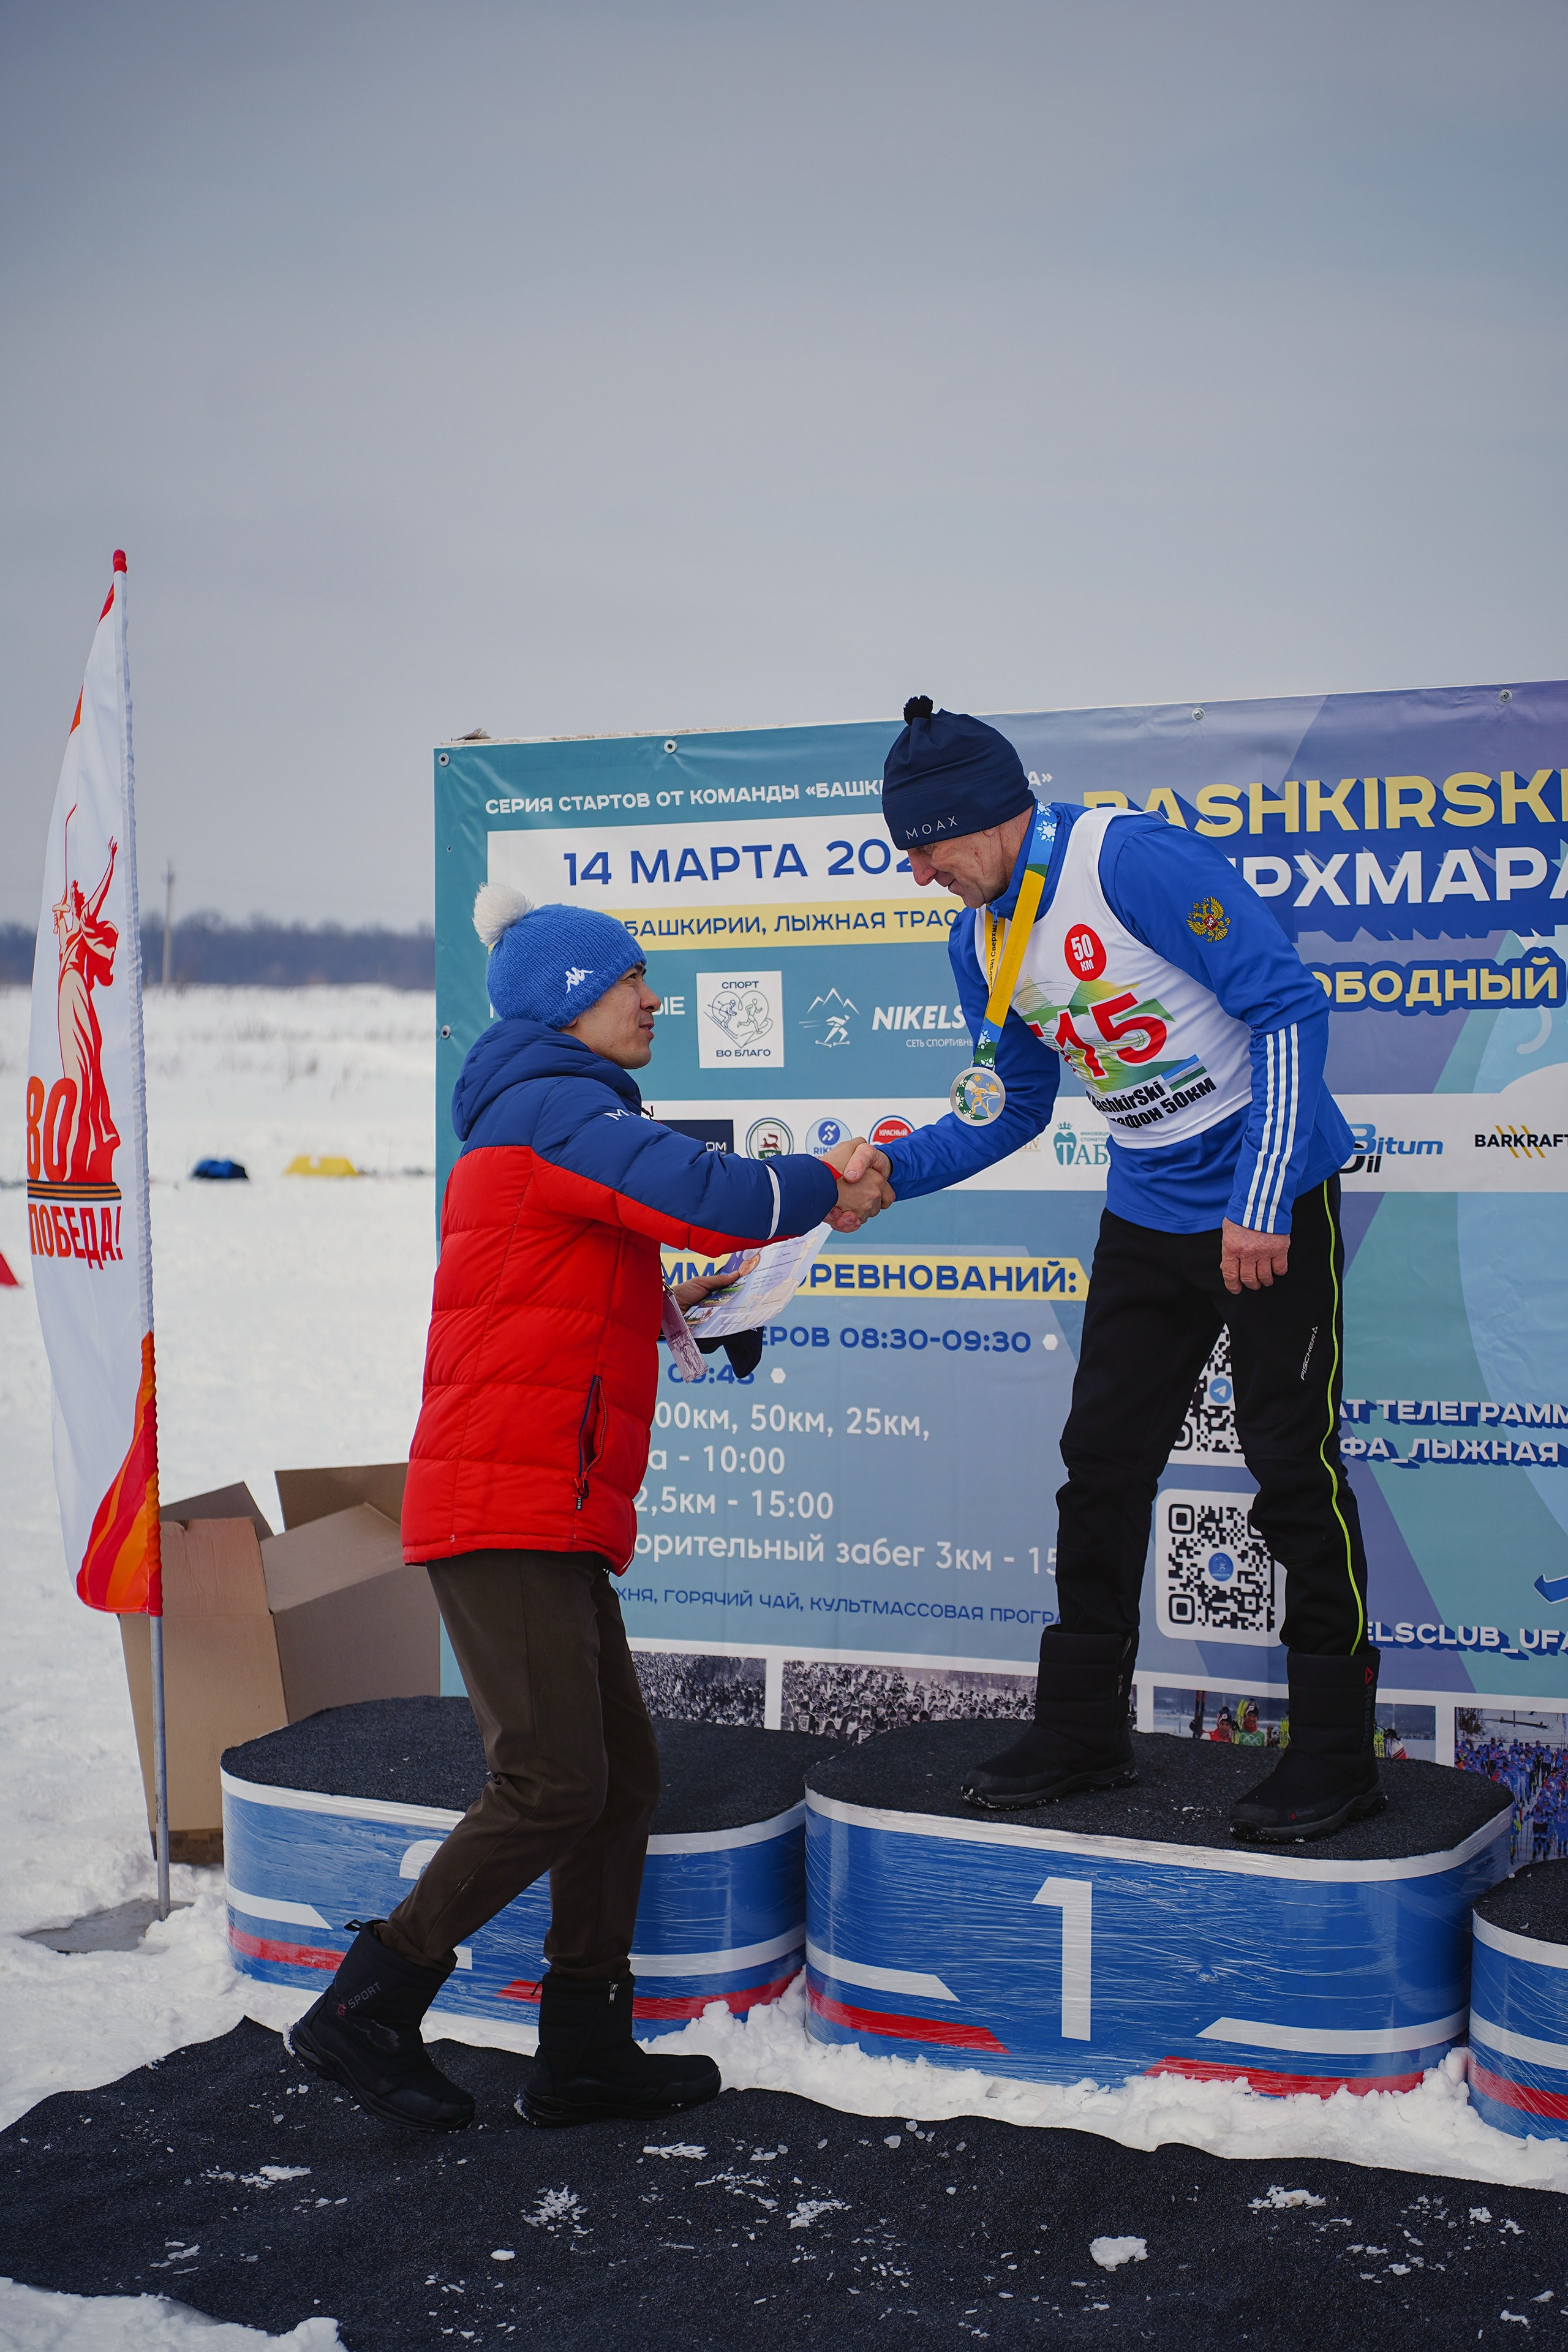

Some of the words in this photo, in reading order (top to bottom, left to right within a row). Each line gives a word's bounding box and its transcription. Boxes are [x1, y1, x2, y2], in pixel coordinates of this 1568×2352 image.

[485, 797, 553, 815] СЕРИЯ
[559, 793, 650, 812] СТАРТОВ
[656, 790, 684, 807] ОТ
[690, 783, 800, 805] КОМАНДЫ
[805, 779, 883, 798] «БАШК
[905, 815, 959, 840] MOAX
[563, 851, 612, 886] 14
[630, 843, 809, 884] МАРТА
[774, 911, 886, 933] ЛЫЖНАЯ
[1070, 933, 1095, 961] 50
[872, 1004, 967, 1031] NIKELS
[715, 1049, 733, 1058] ВО
[734, 1048, 771, 1058] БЛАГО
[906, 1039, 925, 1048] СЕТЬ
[26, 1076, 78, 1182] 80
[879, 1128, 908, 1137] КРАСНЫЙ
[1056, 1142, 1111, 1166] ТАБ
[28, 1204, 123, 1270] ПОБЕДА!
[797, 1260, 1077, 1293] РЕВНОВАНИЙ:
[839, 1327, 1031, 1353] 08:30-09:30
[1300, 1333, 1316, 1381] FISCHER
[655, 1401, 738, 1434] 00км,
[750, 1404, 834, 1438] 50км,
[846, 1406, 930, 1441] 25км,
[703, 1445, 785, 1475] 10:00
[1340, 1437, 1559, 1464] ФА_ЛЫЖНАЯ
[751, 1489, 834, 1520] 15:00
[835, 1537, 925, 1567] забег
[935, 1540, 992, 1572] 3км
[615, 1587, 658, 1605] ХНЯ,
[664, 1589, 753, 1608] ГОРЯЧИЙ
[760, 1593, 804, 1612] ЧАЙ,
[810, 1596, 984, 1621] КУЛЬТМАССОВАЯ
[1031, 1876, 1093, 2041] 1
[348, 1981, 381, 2009] SPORT
